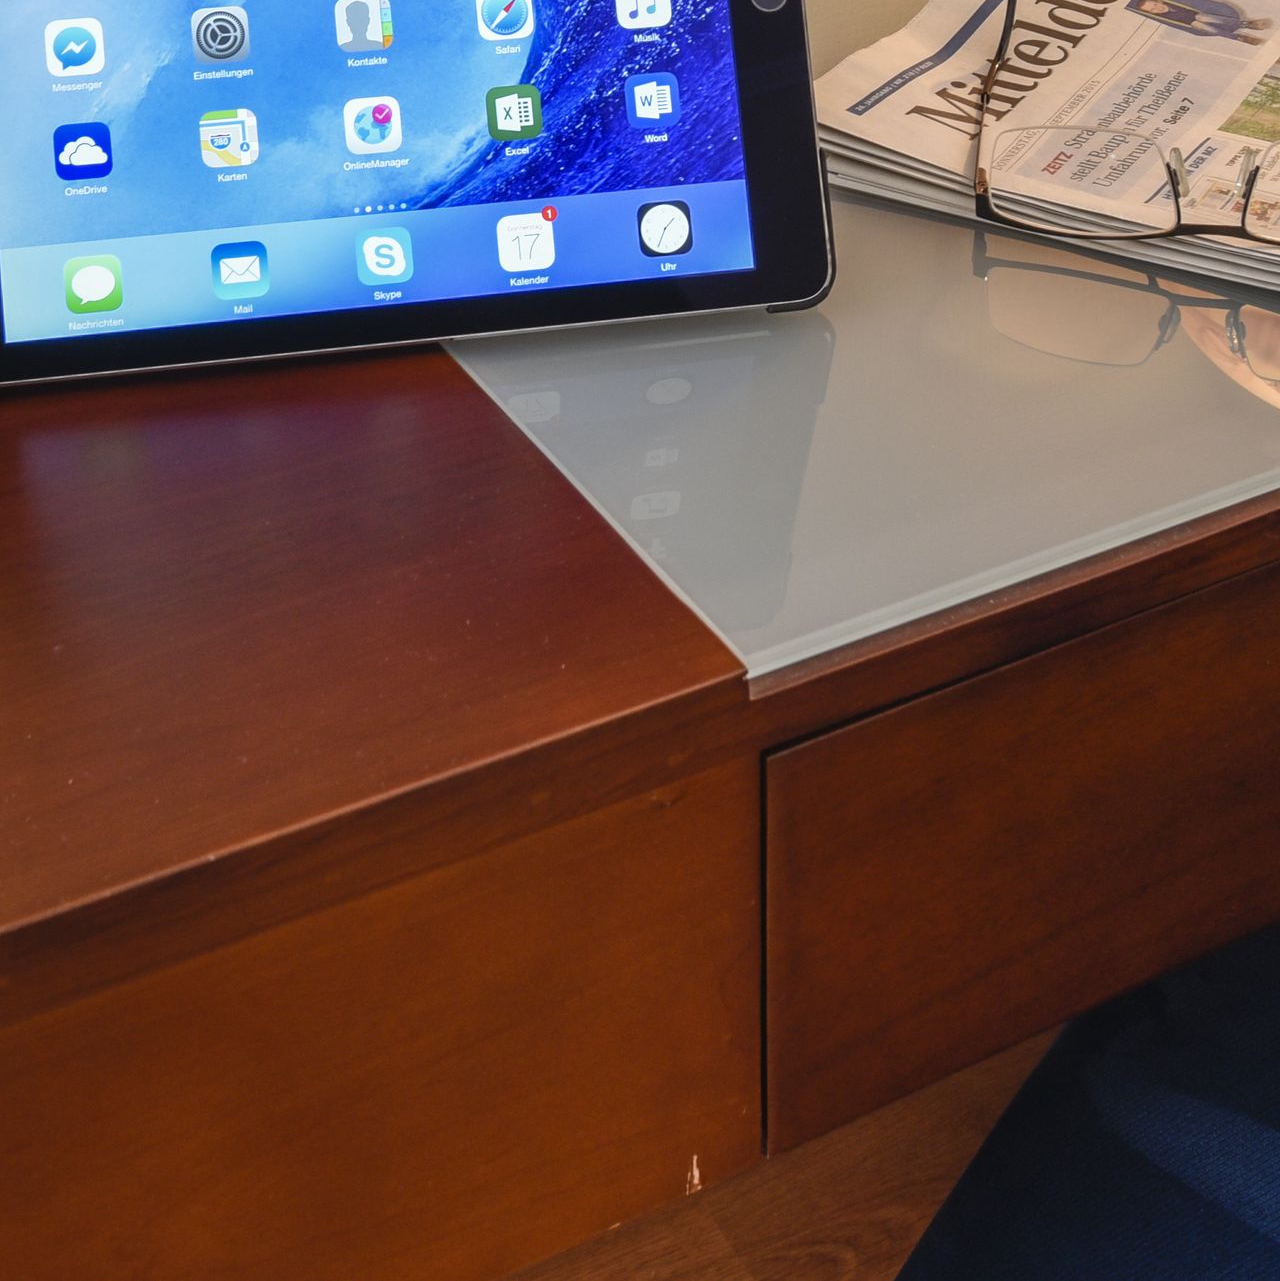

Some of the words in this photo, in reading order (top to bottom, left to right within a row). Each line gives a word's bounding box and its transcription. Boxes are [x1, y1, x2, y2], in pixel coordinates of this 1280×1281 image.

[633, 32, 661, 44] Musik
[495, 43, 521, 55] Safari
[347, 55, 388, 68] Kontakte
[193, 67, 254, 81] Einstellungen
[52, 79, 103, 93] Messenger
[1083, 79, 1100, 96] 2015
[639, 94, 654, 107] W
[503, 105, 513, 121] X
[1162, 104, 1191, 126] Seite
[1041, 150, 1073, 175] ZEITZ
[1063, 72, 1157, 150] Stranbaubehörde
[1070, 153, 1099, 183] stellt
[1127, 109, 1147, 131] für
[1137, 70, 1189, 123] Theißener
[211, 135, 230, 147] 280
[644, 131, 668, 143] Word
[505, 145, 530, 156] Excel
[1189, 154, 1207, 170] DER
[1204, 145, 1218, 159] MZ
[343, 157, 410, 172] OnlineManager
[217, 171, 248, 183] Karten
[64, 184, 108, 197] OneDrive
[512, 232, 541, 261] 17
[374, 243, 396, 269] S
[660, 261, 677, 272] Uhr
[510, 273, 549, 287] Kalender
[373, 289, 402, 302] Skype
[233, 304, 253, 314] Mail
[68, 317, 125, 331] Nachrichten
